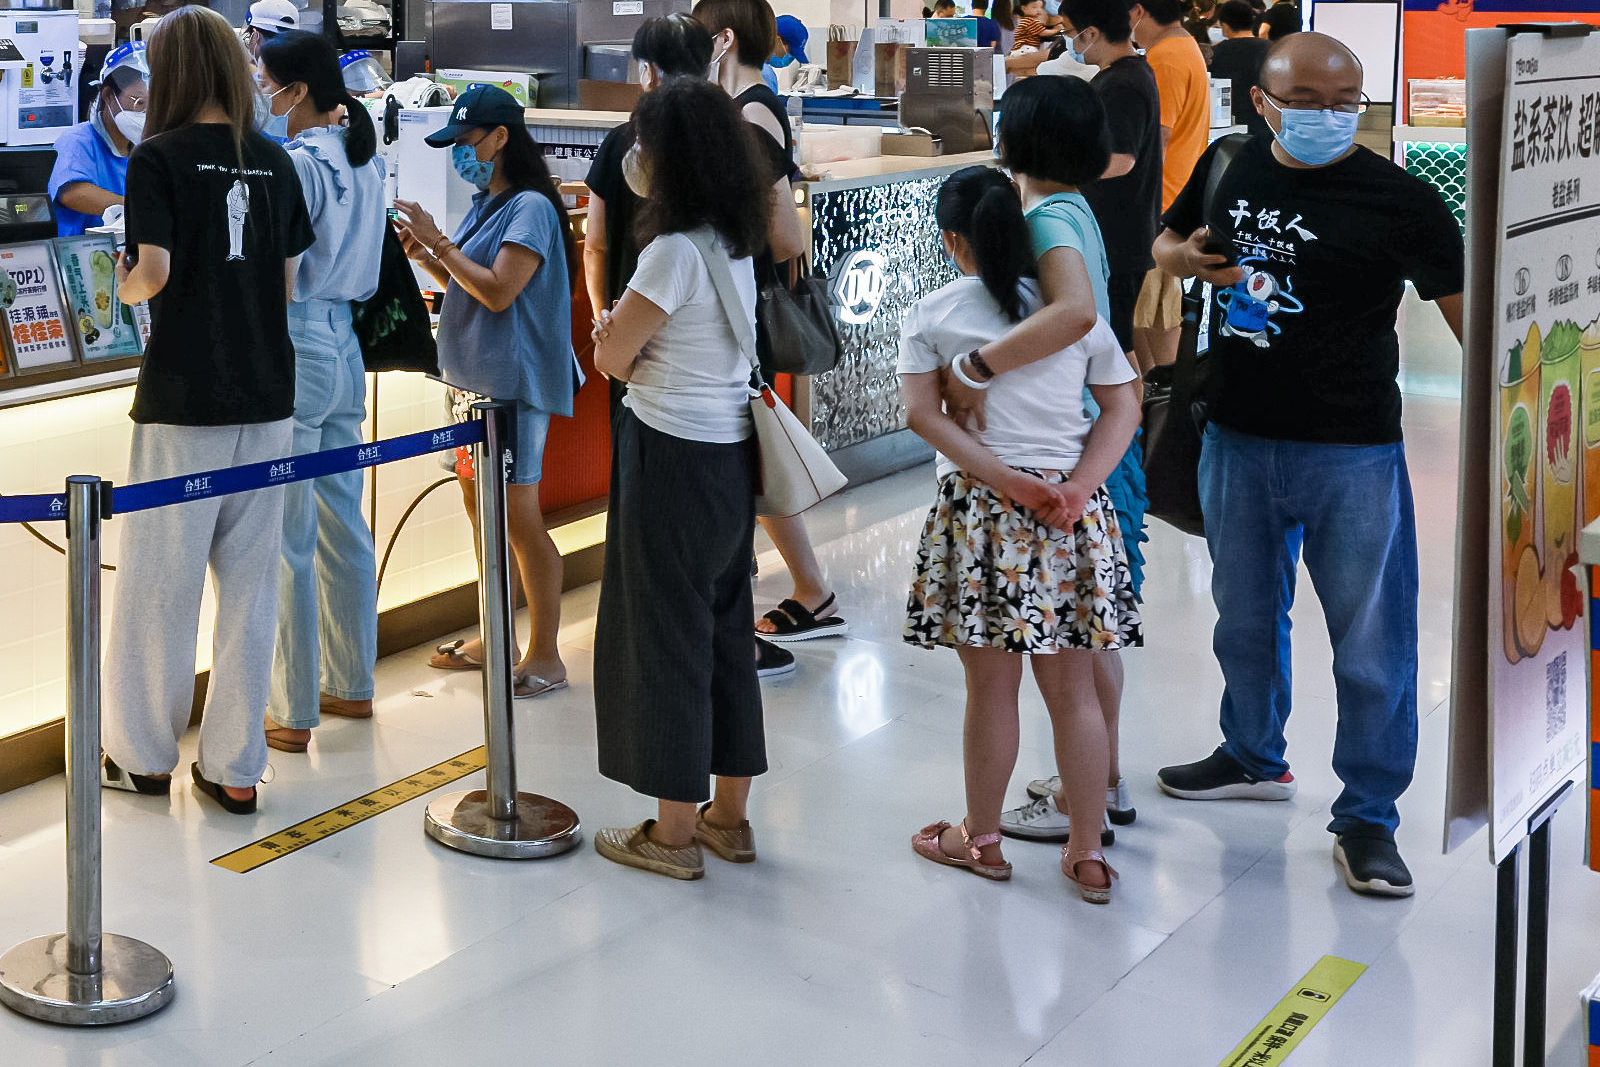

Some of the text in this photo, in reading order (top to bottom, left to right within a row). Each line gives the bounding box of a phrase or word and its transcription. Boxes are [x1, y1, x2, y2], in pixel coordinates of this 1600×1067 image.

[1552, 177, 1581, 209] 老盐系列
[1228, 199, 1319, 242] 干饭人
[1236, 231, 1261, 243] 干饭人
[846, 266, 884, 308] DQ
[8, 305, 50, 324] 桂源铺
[12, 319, 64, 345] 桂桂茶
[432, 430, 455, 445] 合生汇
[357, 445, 382, 461] 合生汇
[269, 461, 296, 478] 合生汇
[184, 476, 212, 493] 合生汇
[275, 837, 311, 854] Please
[318, 823, 344, 835] Wait
[351, 802, 390, 821] Outside
[459, 764, 480, 774] Line
